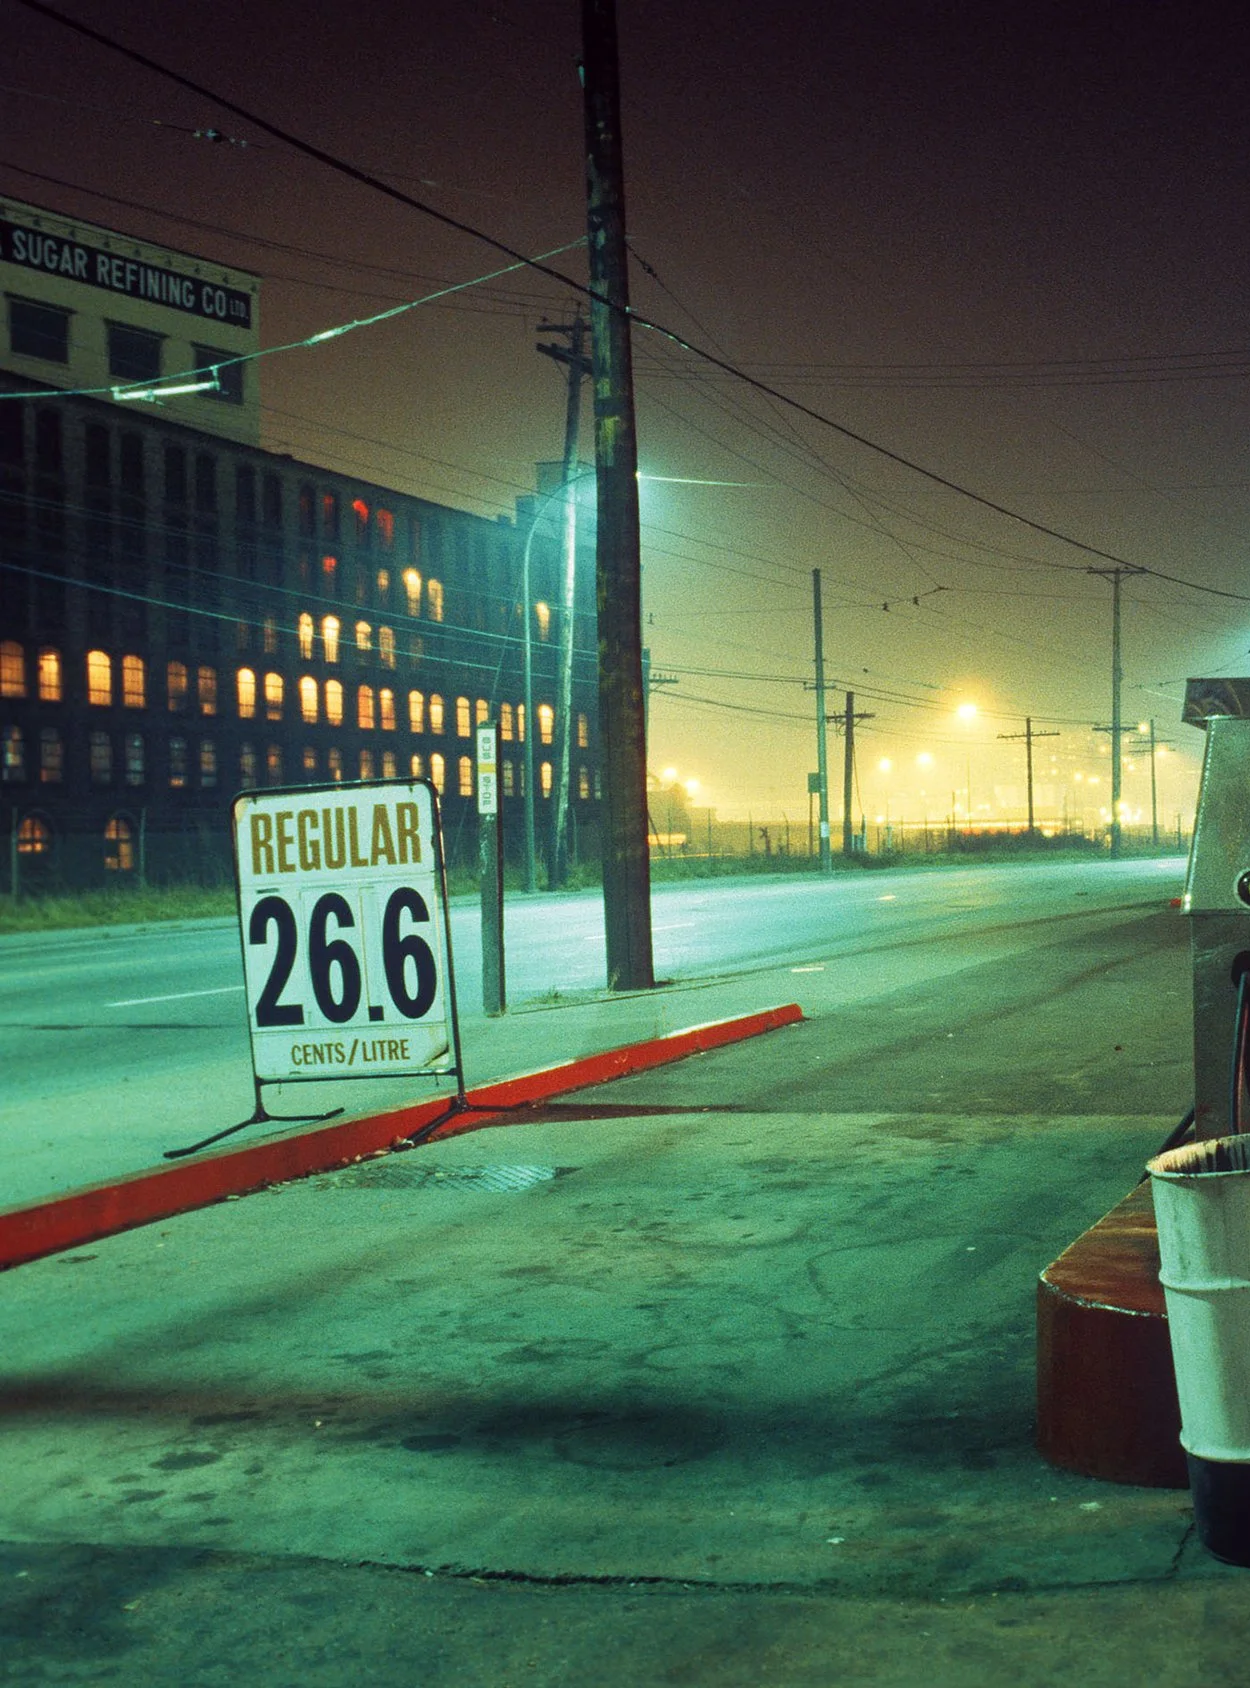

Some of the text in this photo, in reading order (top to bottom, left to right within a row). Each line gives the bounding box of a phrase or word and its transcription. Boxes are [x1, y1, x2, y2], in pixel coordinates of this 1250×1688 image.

[12, 229, 88, 279] SUGAR
[96, 254, 195, 309] REFINING
[202, 286, 227, 318] CO
[250, 801, 422, 876] REGULAR
[249, 887, 437, 1028] 26.6
